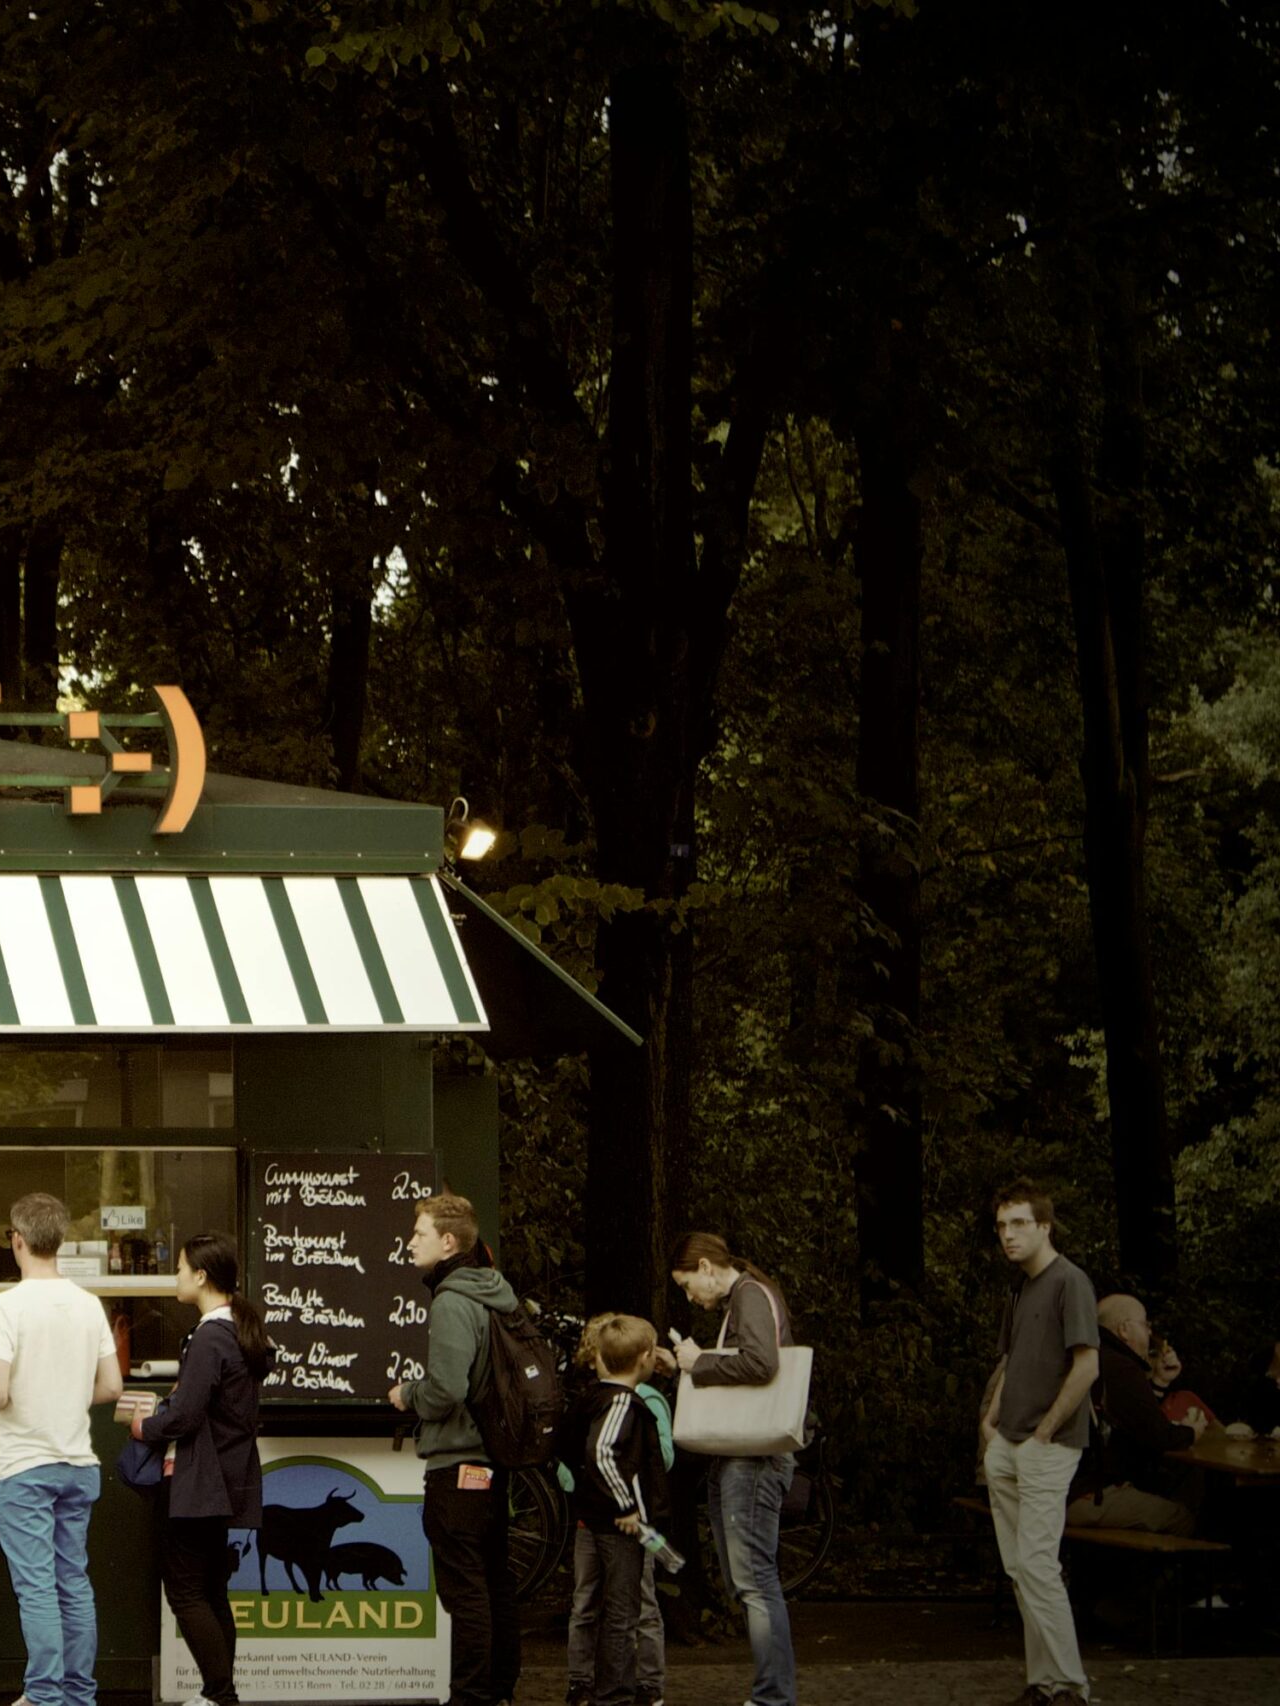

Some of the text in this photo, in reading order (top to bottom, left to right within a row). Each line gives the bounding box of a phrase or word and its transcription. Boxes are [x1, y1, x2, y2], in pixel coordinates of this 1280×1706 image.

[66, 684, 206, 835] :-)
[264, 1163, 360, 1188] Currywurst
[266, 1188, 292, 1206] mit
[299, 1186, 366, 1207] Brötchen
[121, 1215, 144, 1225] Like
[263, 1224, 347, 1250] Bratwurst
[266, 1248, 285, 1262] im
[292, 1248, 366, 1274] Brötchen
[262, 1284, 324, 1309] Boulette
[264, 1308, 293, 1324] mit
[299, 1307, 366, 1328] Brötchen
[262, 1369, 286, 1387] mit
[292, 1366, 355, 1394] Brötchen
[230, 1600, 424, 1629] EULAND
[250, 1666, 270, 1676] und
